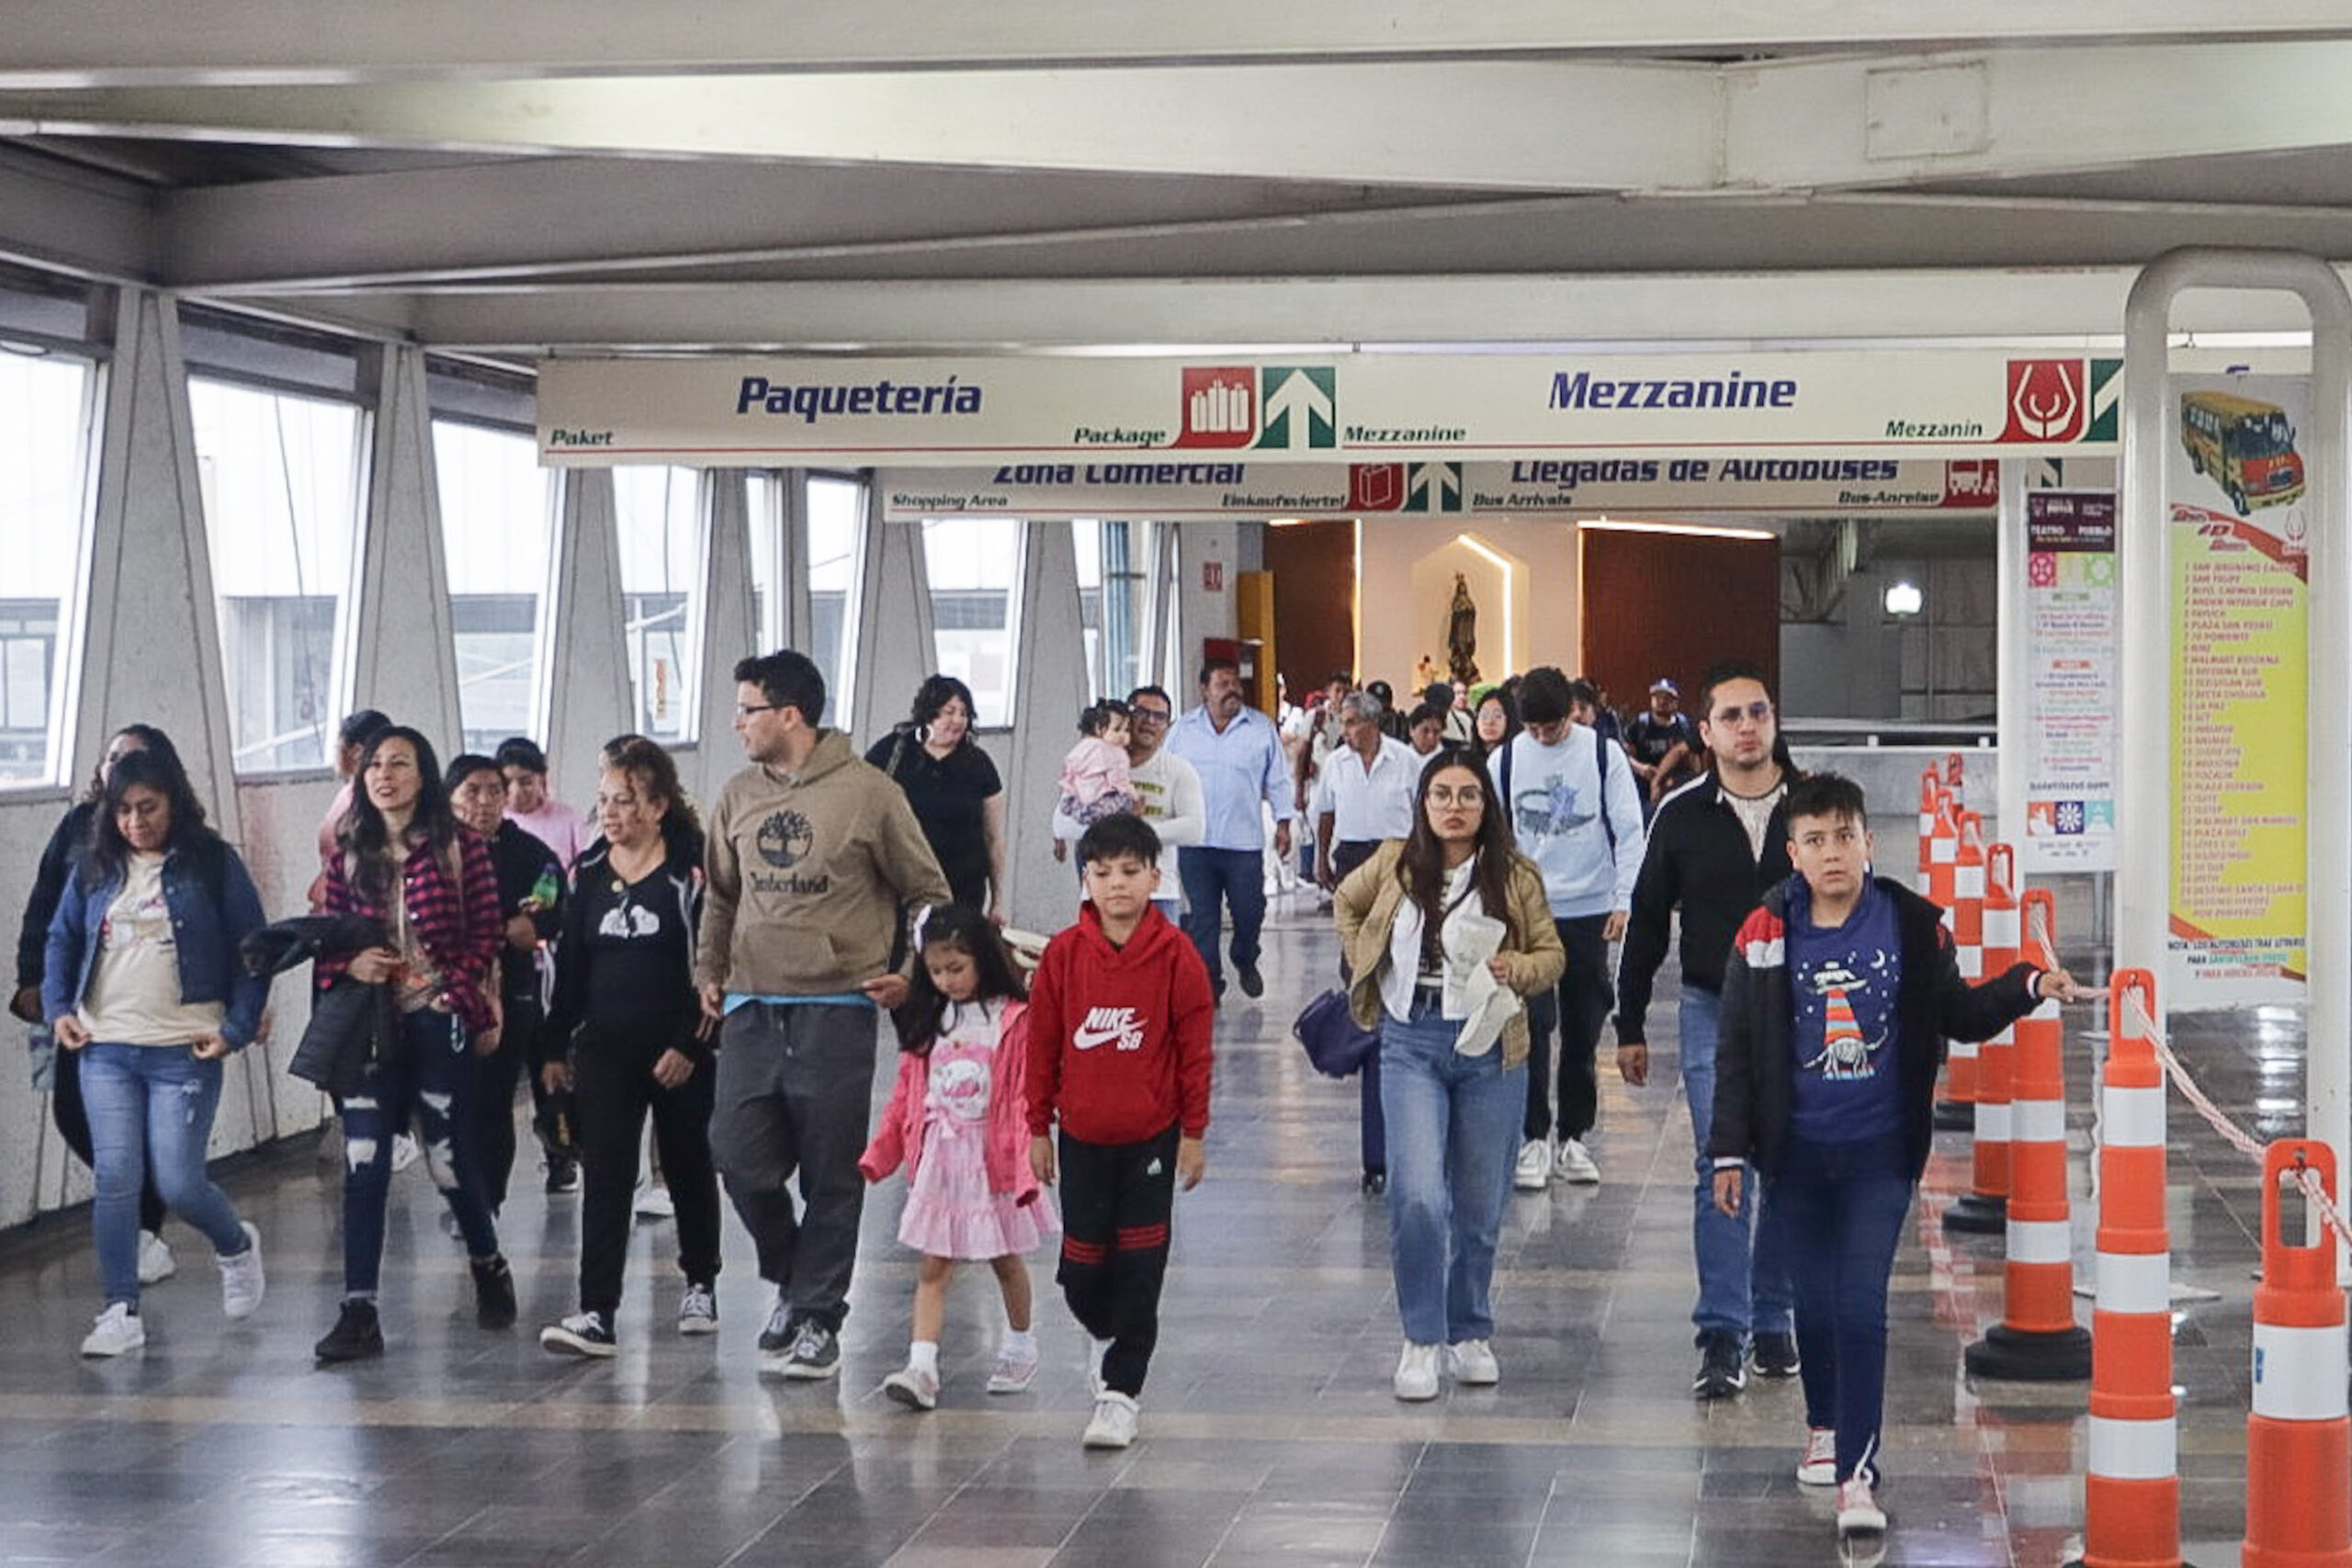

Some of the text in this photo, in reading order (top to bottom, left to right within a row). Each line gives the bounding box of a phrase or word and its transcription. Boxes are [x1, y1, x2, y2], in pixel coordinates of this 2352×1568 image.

[737, 375, 982, 424] Paquetería
[1548, 369, 1797, 410] Mezzanine
[550, 429, 613, 446] Paket
[1074, 427, 1166, 448] Package
[1345, 425, 1466, 442] Mezzanine
[1885, 419, 1984, 438] Mezzanin
[993, 464, 1074, 485] Zona
[1512, 459, 1899, 490] Llegadas de Autobuses
[892, 494, 1008, 511] Shopping Area
[1473, 493, 1572, 507] Bus Arrivals
[751, 872, 828, 894] mberland
[1085, 1007, 1136, 1030] NIKE
[1116, 1031, 1144, 1051] SB
